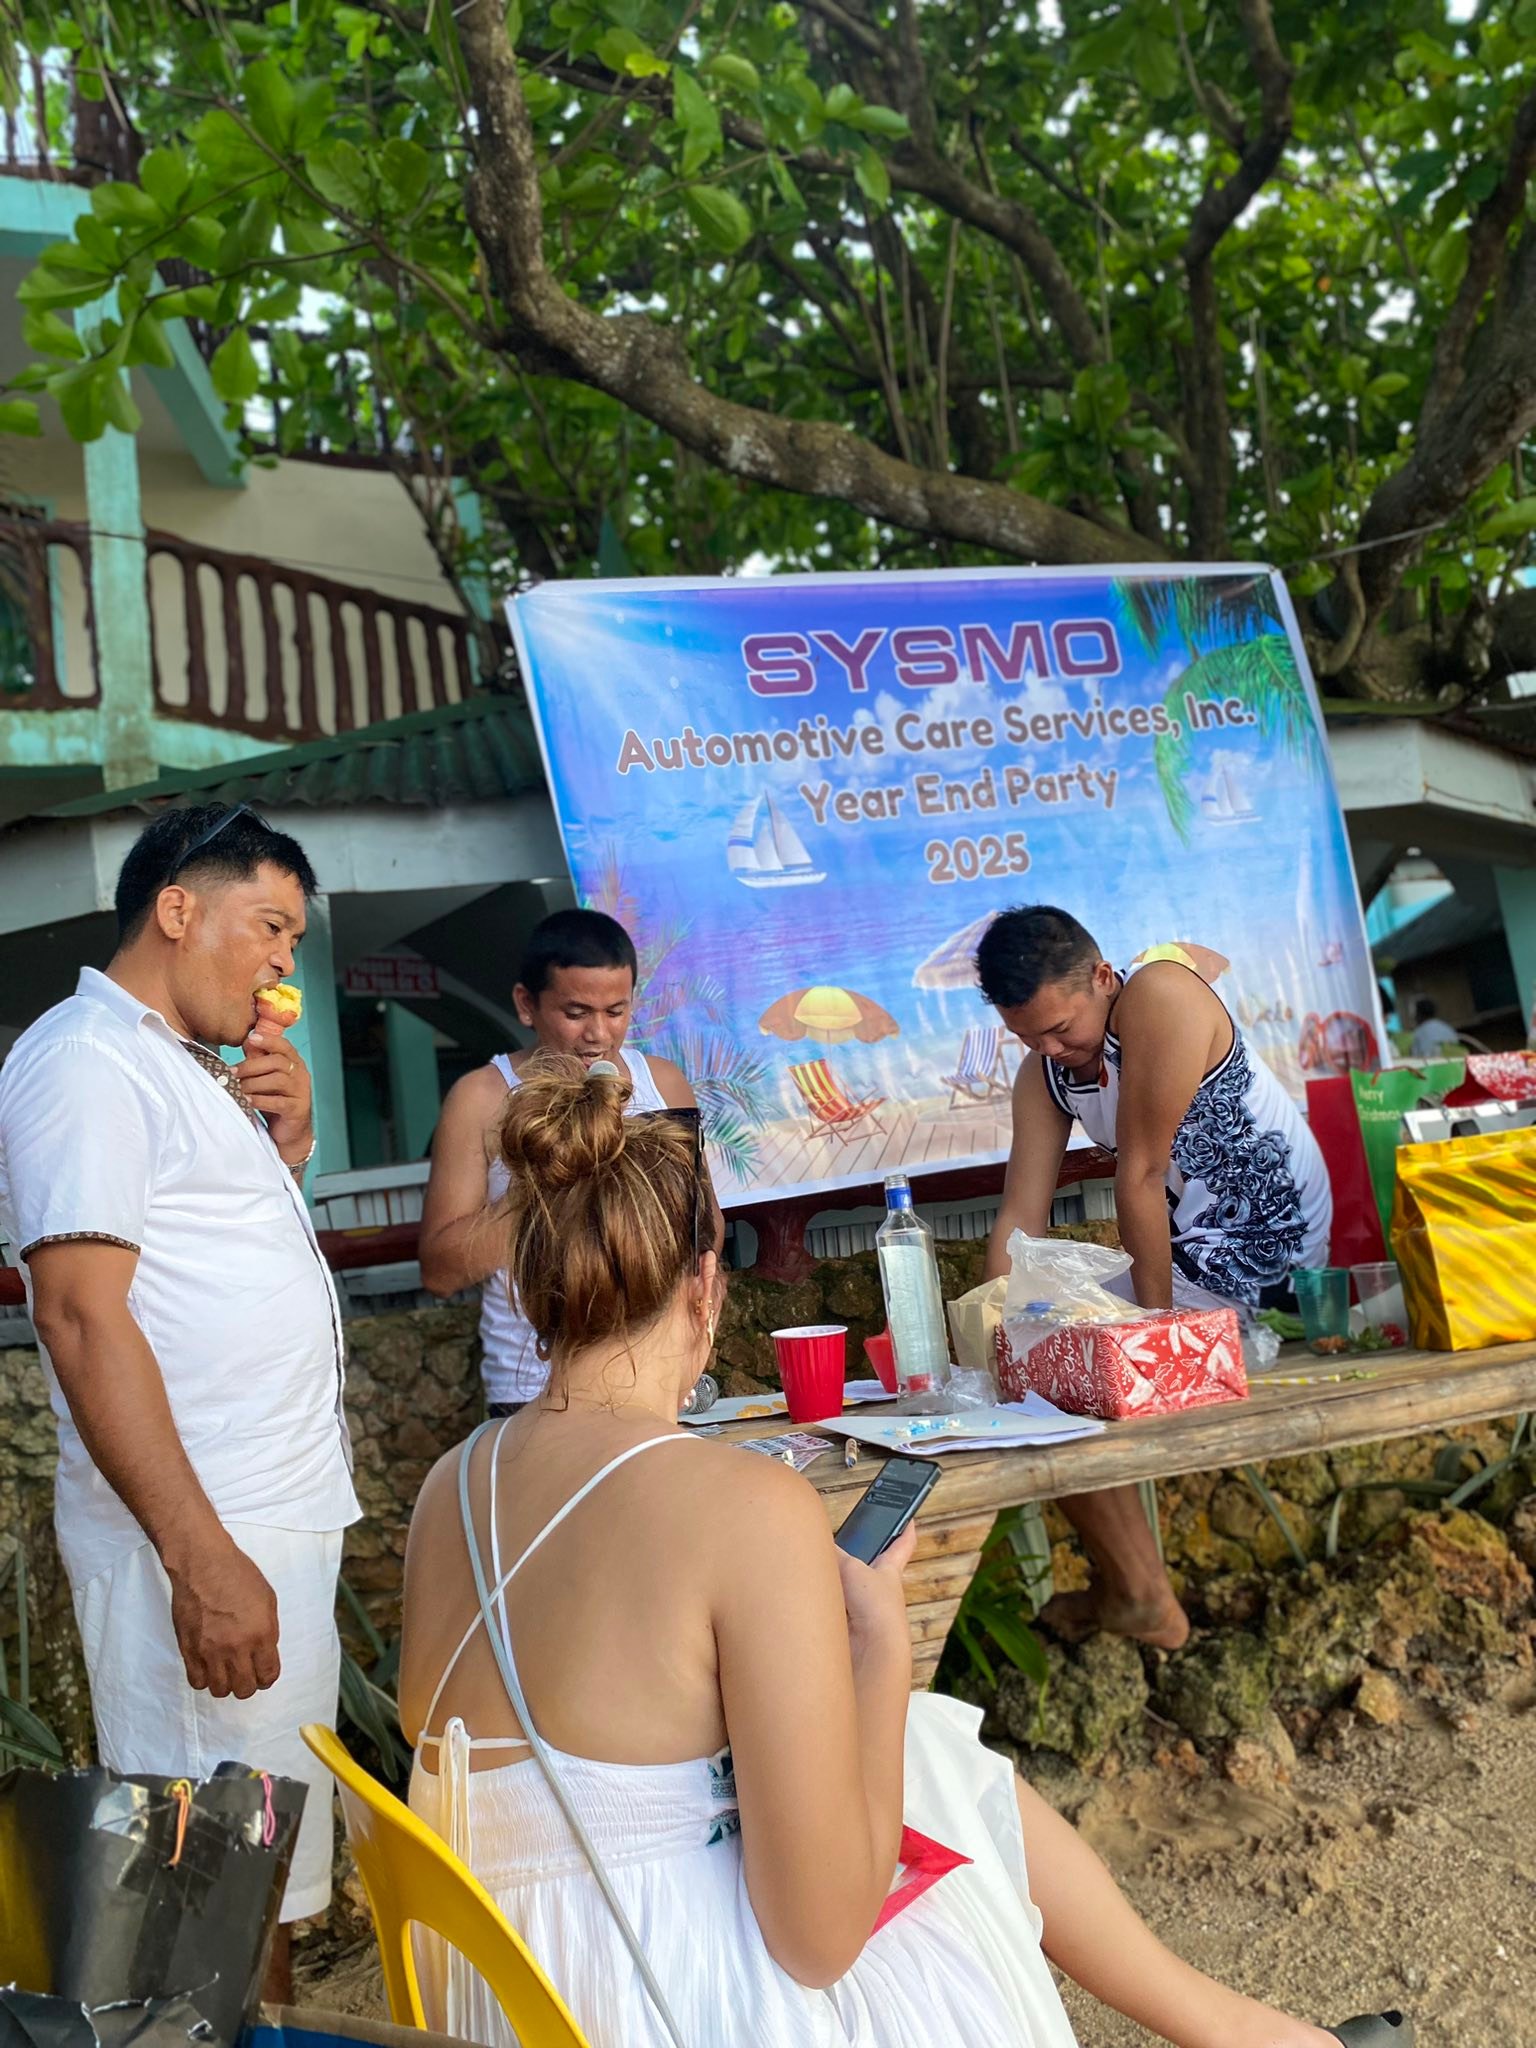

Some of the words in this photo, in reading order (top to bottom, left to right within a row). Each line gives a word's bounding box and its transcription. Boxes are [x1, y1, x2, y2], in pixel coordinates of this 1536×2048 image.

[742, 618, 1121, 697] SYSMO
[617, 715, 885, 775] Automotive
[894, 712, 995, 753] Care
[1003, 698, 1180, 744] Services,
[1184, 690, 1255, 731] Inc.
[799, 780, 904, 825] Year
[913, 767, 998, 816] End
[1003, 762, 1118, 810] Party
[925, 831, 1031, 883] 2025
